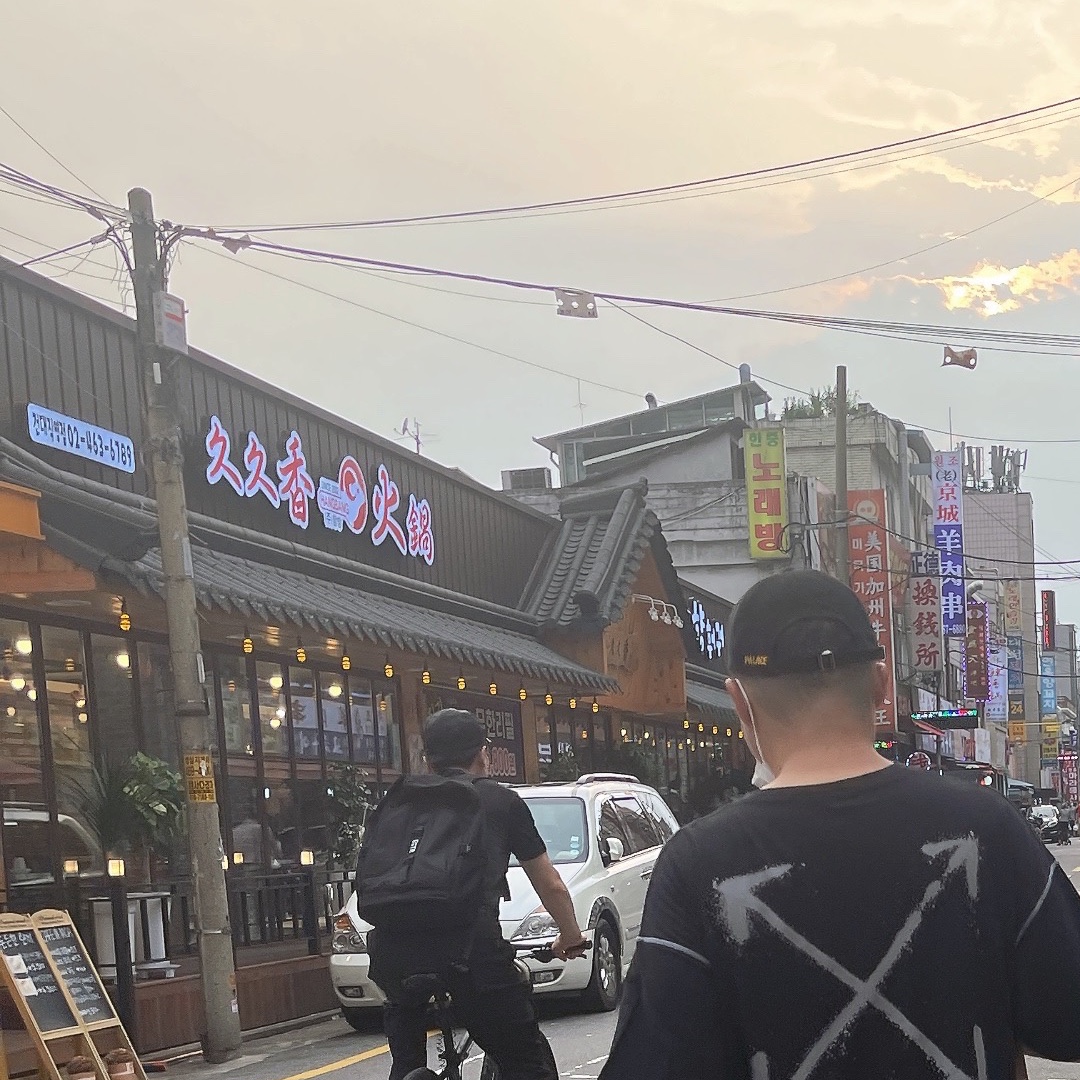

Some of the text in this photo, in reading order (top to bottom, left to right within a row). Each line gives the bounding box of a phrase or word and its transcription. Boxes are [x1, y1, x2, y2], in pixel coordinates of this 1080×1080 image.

[67, 423, 132, 467] 02-463-6789
[206, 415, 315, 529] 久久香
[752, 453, 782, 552] 노래방
[936, 483, 960, 524] 京城
[911, 552, 939, 575] 正德
[936, 528, 965, 620] 羊肉串
[1010, 703, 1024, 715] 24
